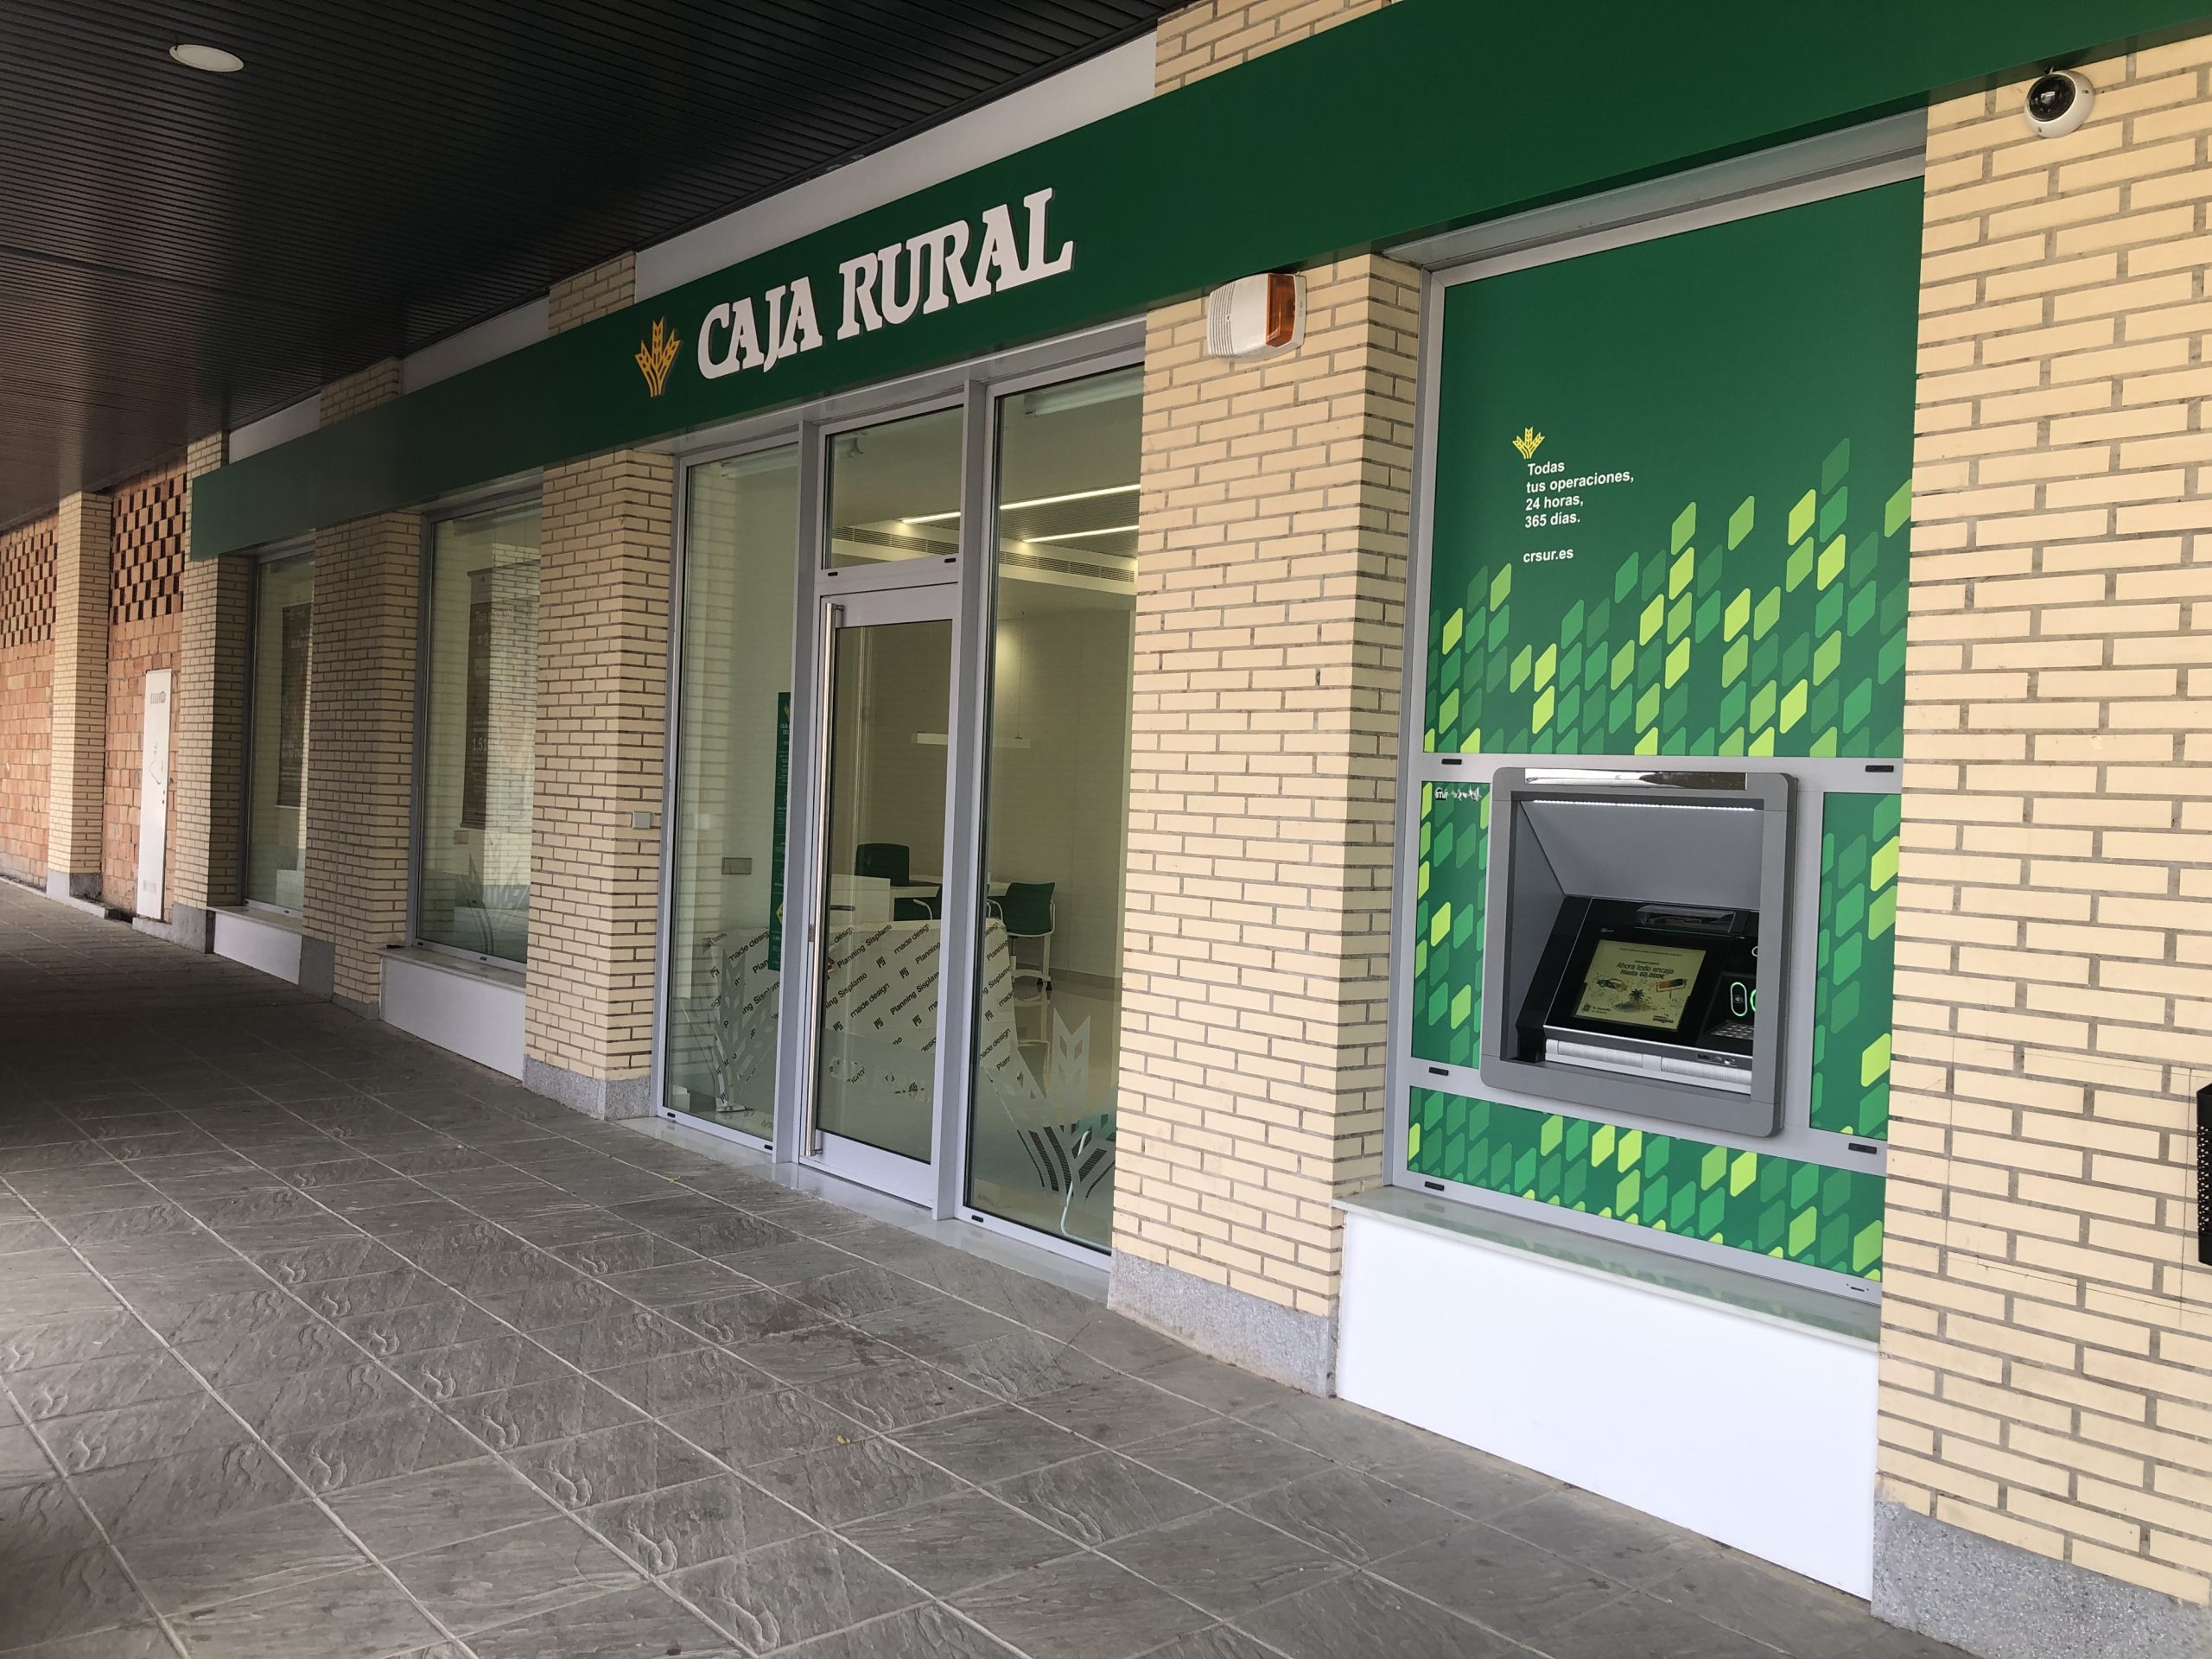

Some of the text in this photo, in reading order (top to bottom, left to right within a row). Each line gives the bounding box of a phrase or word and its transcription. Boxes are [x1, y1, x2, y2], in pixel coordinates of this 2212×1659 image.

[696, 187, 1077, 379] CAJA RURAL
[1527, 461, 1566, 476] Todas
[1526, 469, 1635, 494] tus operaciones,
[1525, 493, 1585, 512] 24 horas,
[1524, 512, 1581, 529] 365 días.
[1522, 547, 1574, 563] crsur.es
[836, 924, 893, 969] Planning Sisplamo
[893, 923, 931, 955] made design
[837, 972, 868, 998] Sisplamo
[890, 971, 939, 1015] Planning Sisplam
[850, 1000, 869, 1019] made
[868, 982, 891, 1003] design
[992, 1028, 1011, 1047] design
